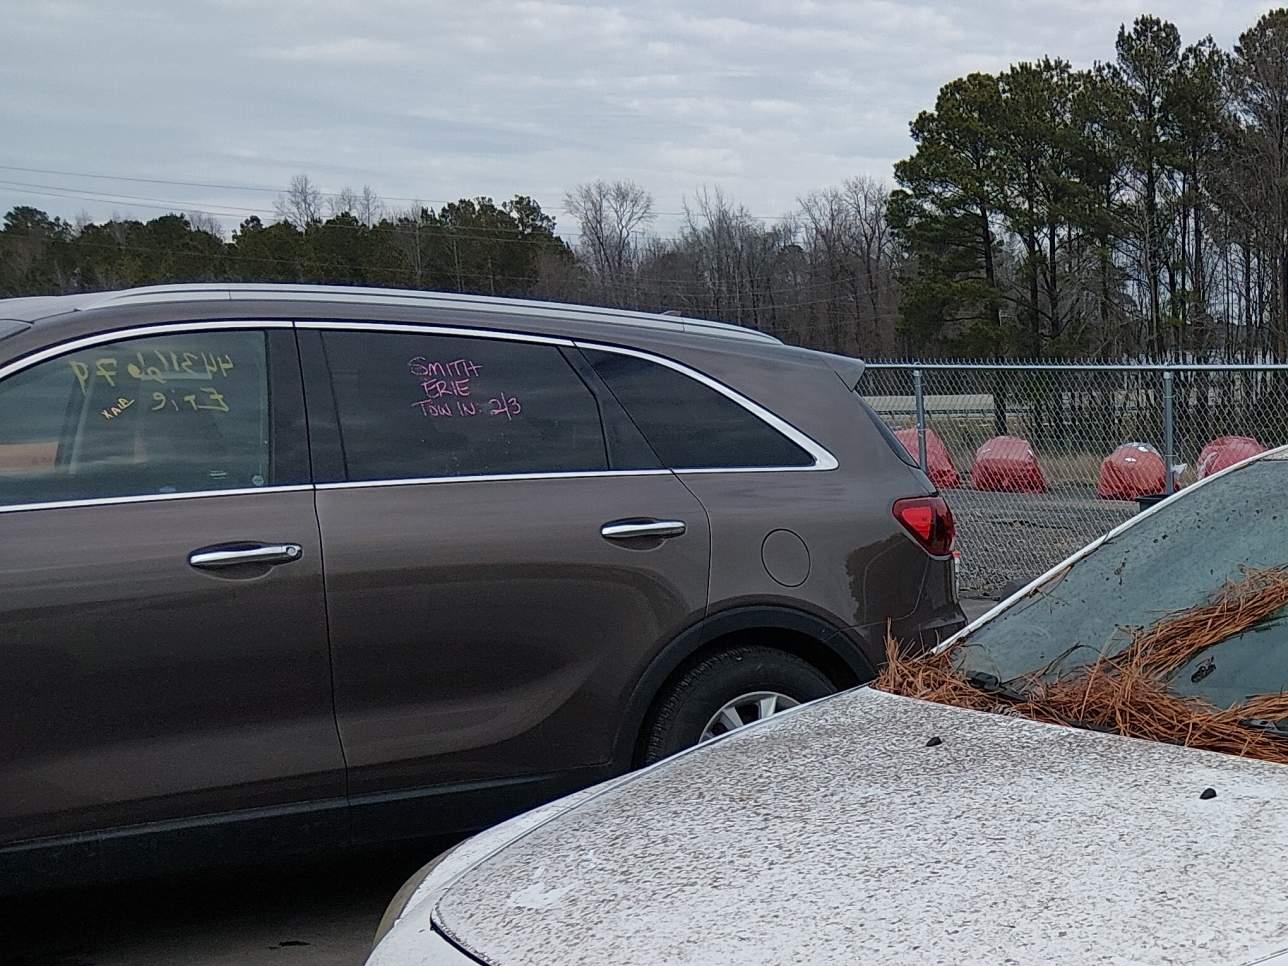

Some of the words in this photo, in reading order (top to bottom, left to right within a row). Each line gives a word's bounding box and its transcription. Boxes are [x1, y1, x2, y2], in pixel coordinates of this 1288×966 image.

[408, 356, 483, 377] SMITH
[421, 378, 470, 398] ERIE
[411, 399, 452, 416] TOW
[488, 392, 521, 420] 2/3
